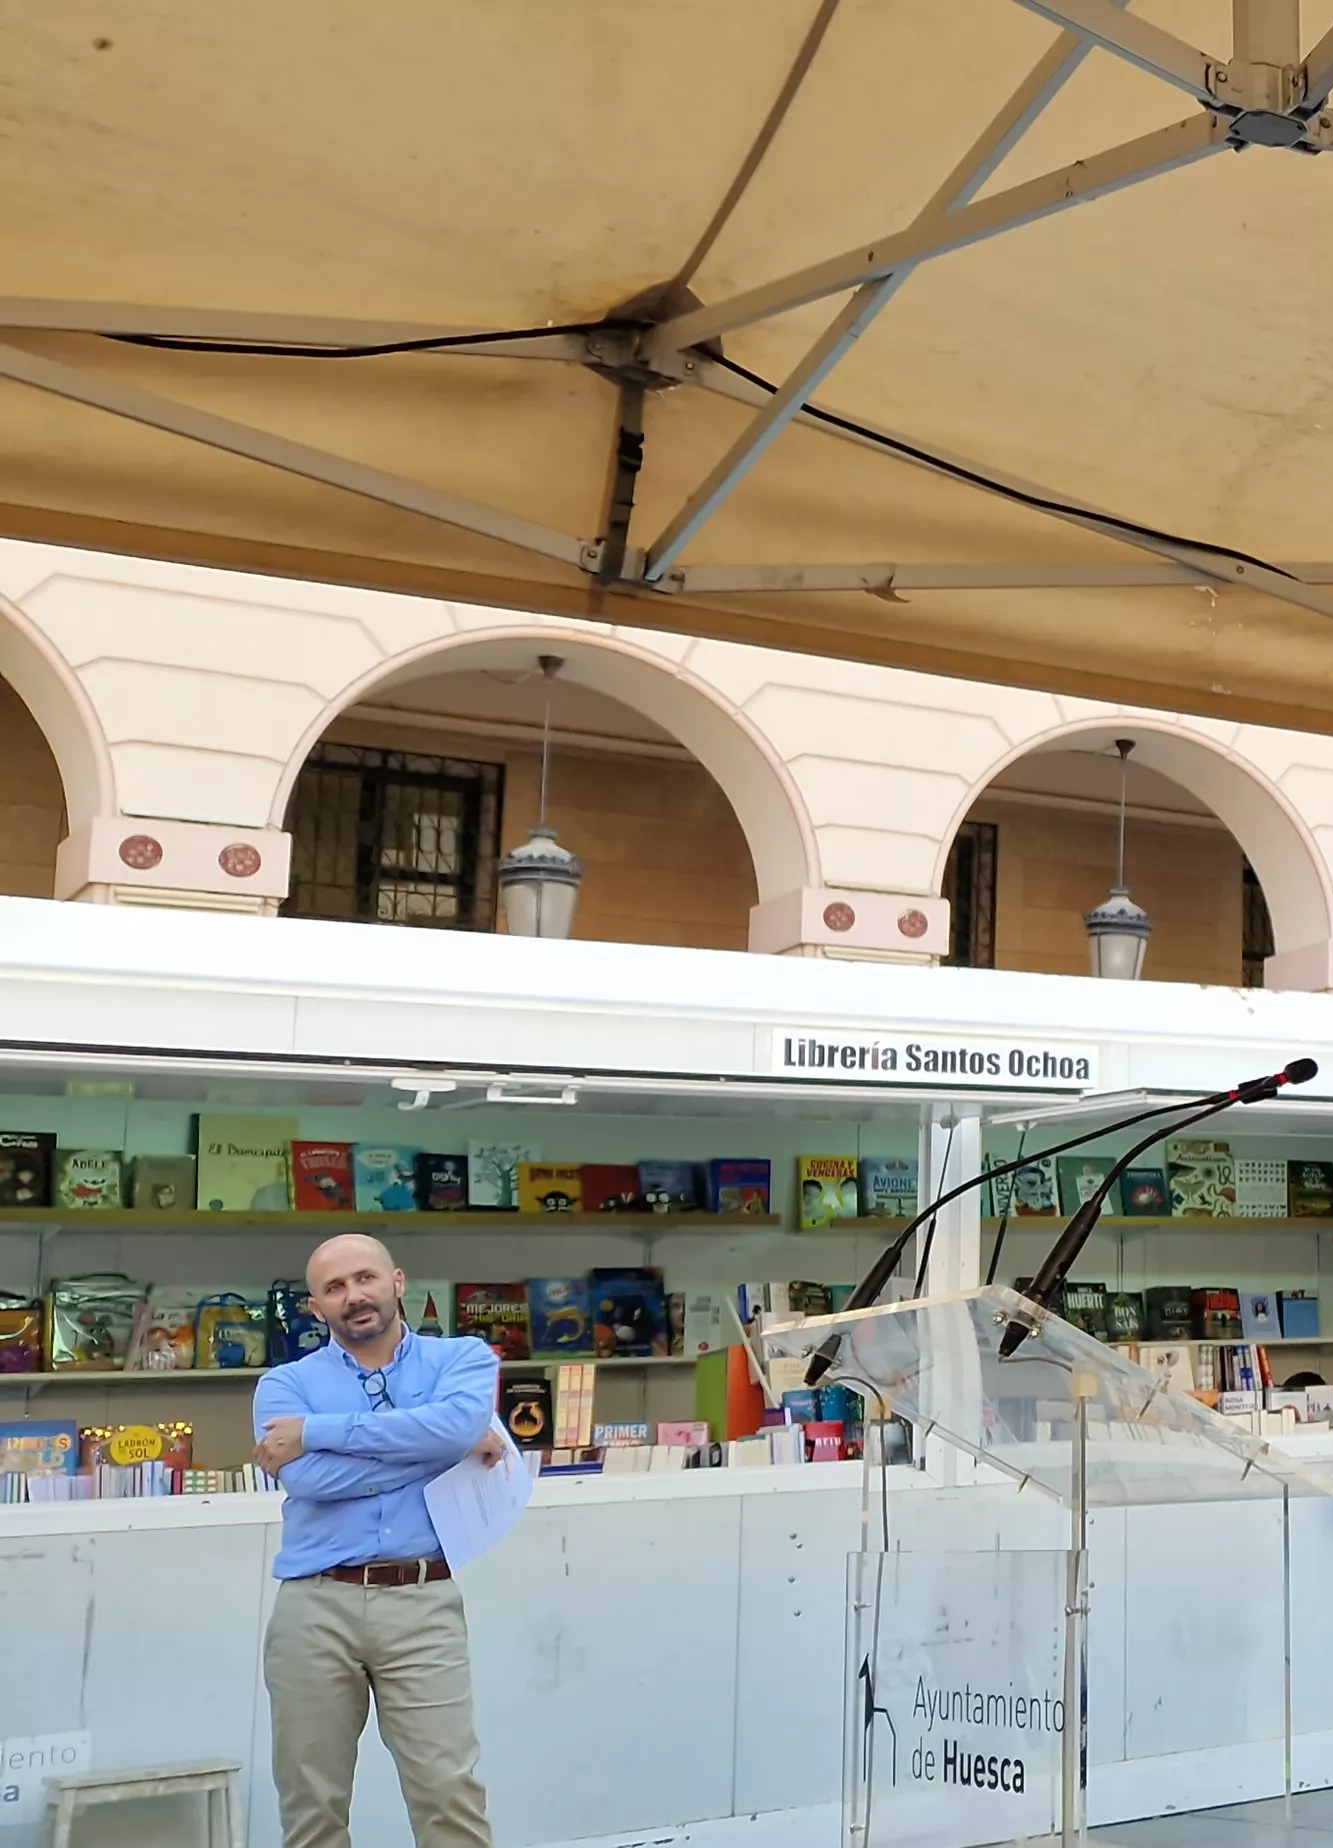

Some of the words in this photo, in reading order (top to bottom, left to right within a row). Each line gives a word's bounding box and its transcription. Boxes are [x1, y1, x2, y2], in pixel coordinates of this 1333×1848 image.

[784, 1037, 897, 1071] Librería
[905, 1044, 1000, 1076] Santos
[1008, 1049, 1090, 1080] Ochoa
[594, 1423, 647, 1439] PRIMER
[128, 1447, 149, 1459] SOL
[912, 1675, 1066, 1733] Ayuntamiento
[912, 1736, 935, 1780] de
[943, 1739, 1026, 1794] Huesca
